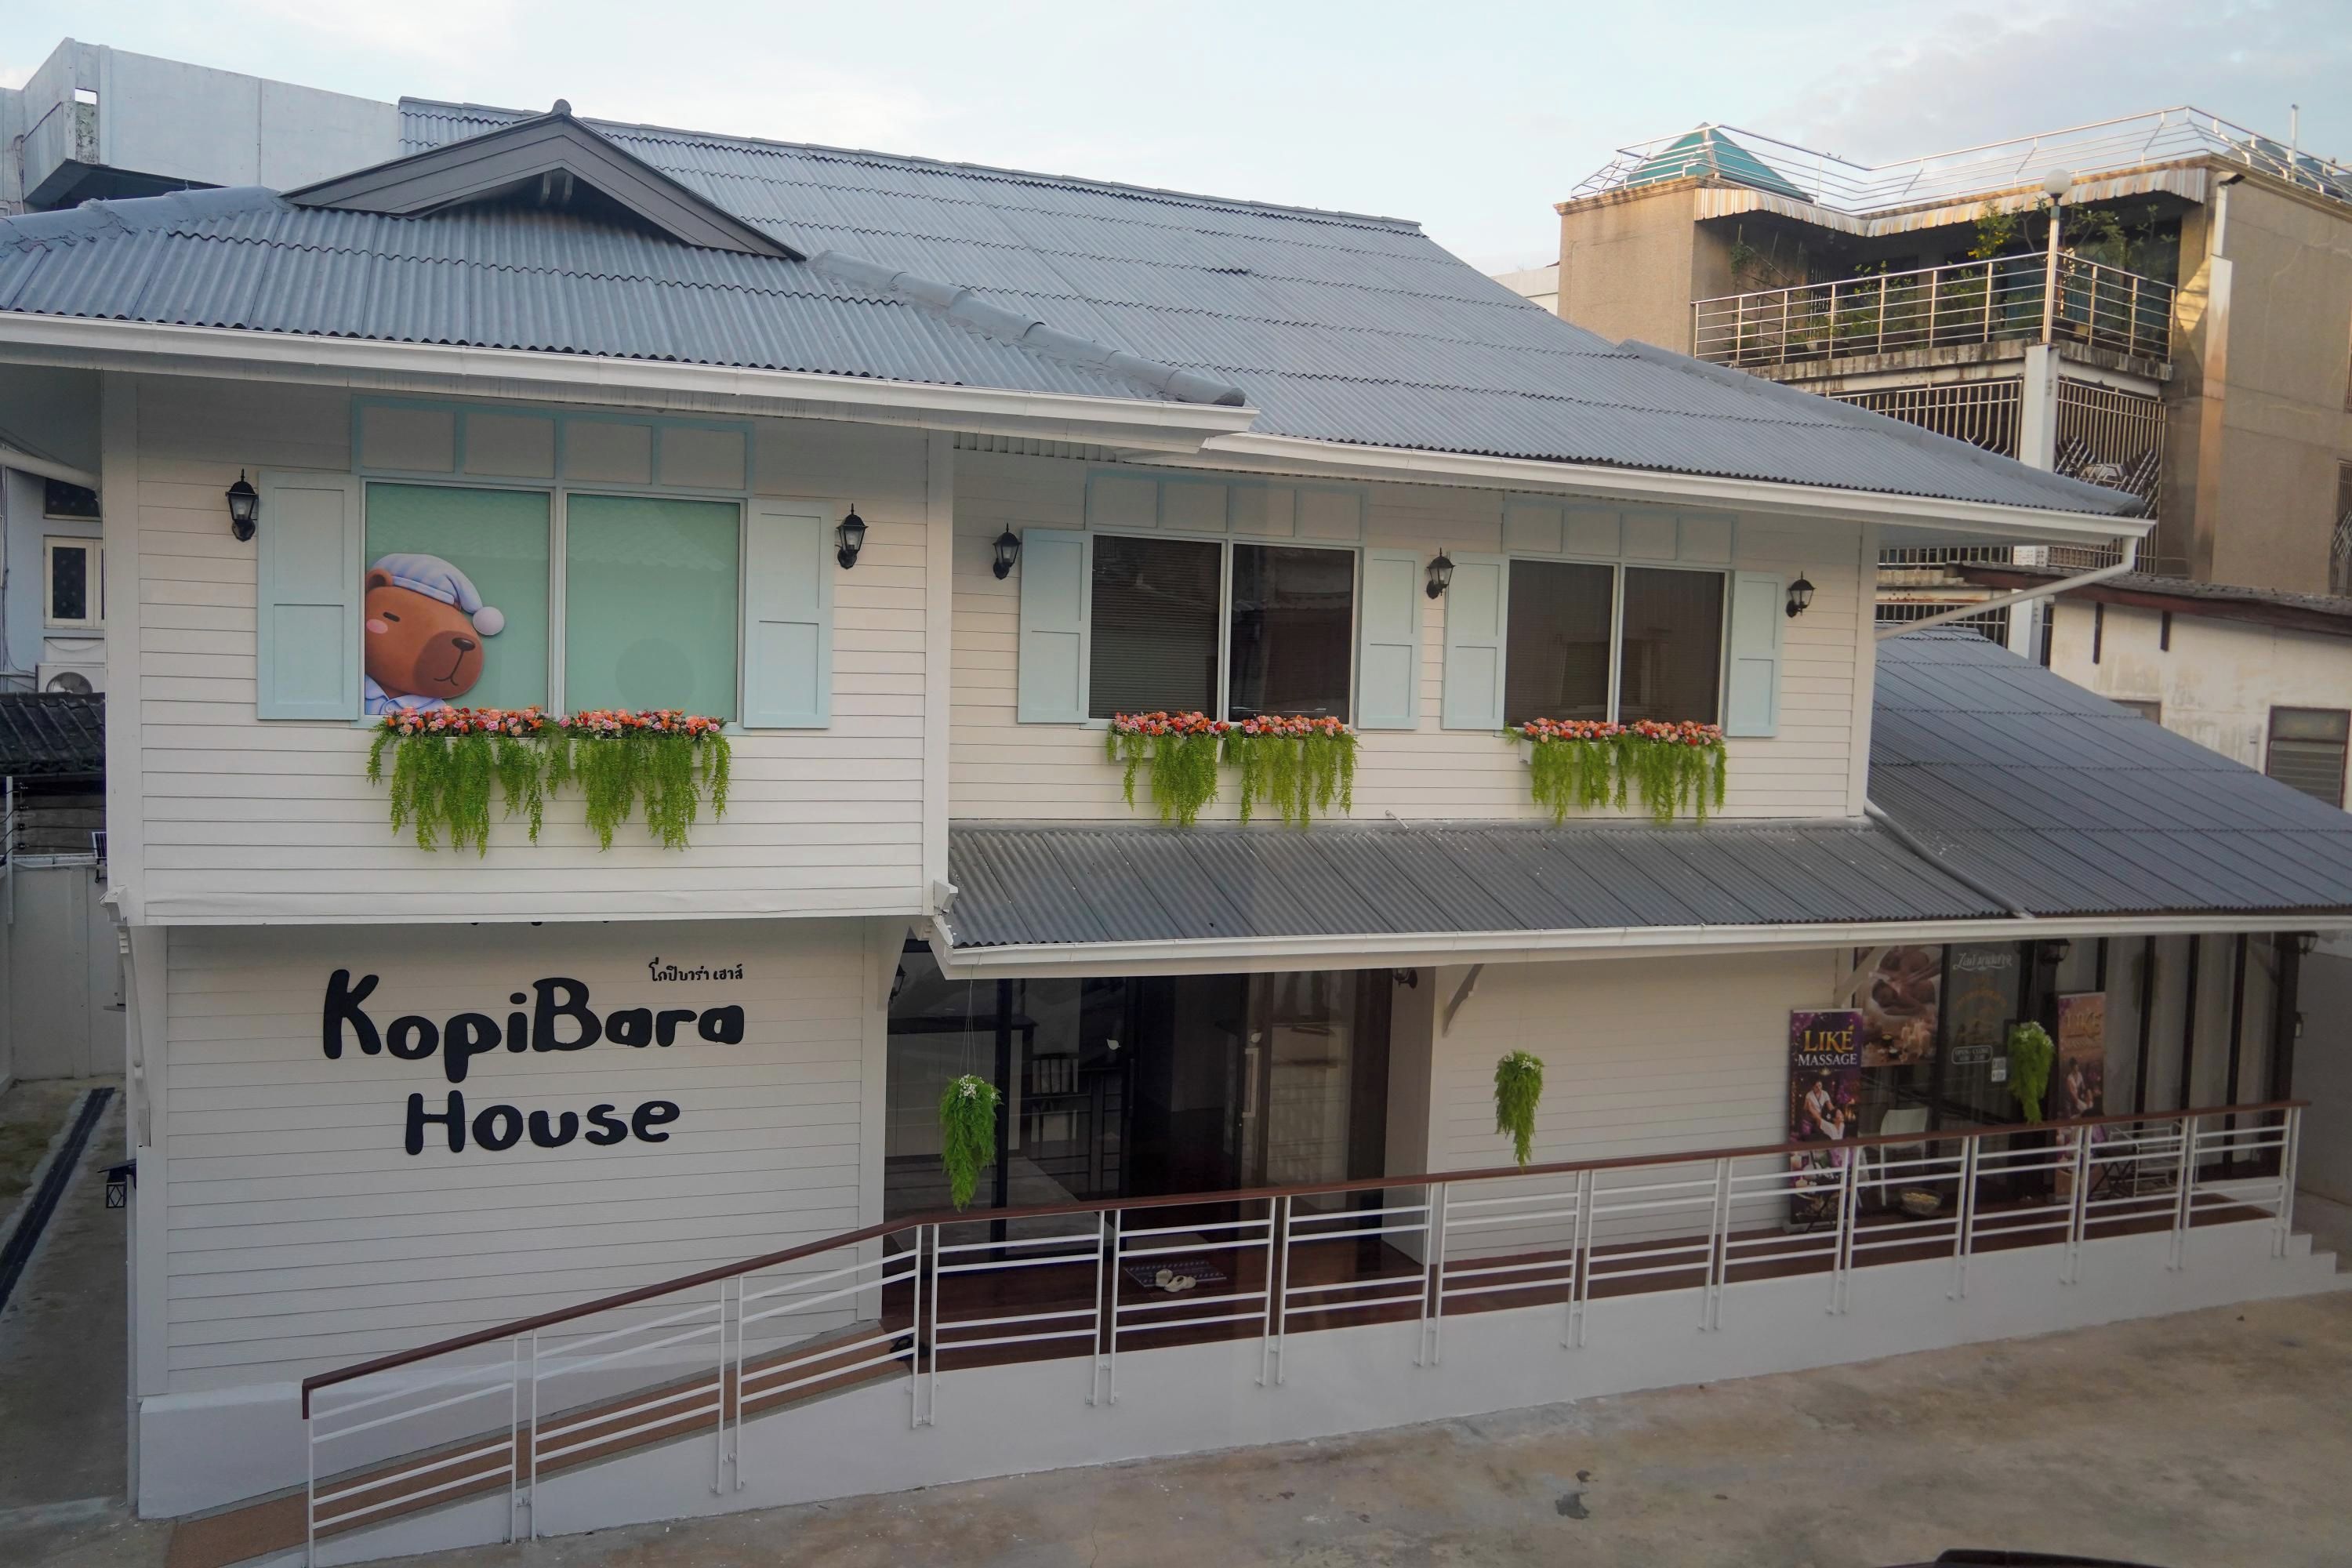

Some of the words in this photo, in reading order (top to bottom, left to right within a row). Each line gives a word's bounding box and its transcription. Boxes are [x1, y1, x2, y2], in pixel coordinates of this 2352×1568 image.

[713, 964, 743, 980] เฮาส์
[323, 968, 745, 1083] KopiBara
[1803, 1029, 1854, 1054] LIKE
[1798, 1053, 1857, 1066] MASSAGE
[405, 1090, 681, 1156] House
